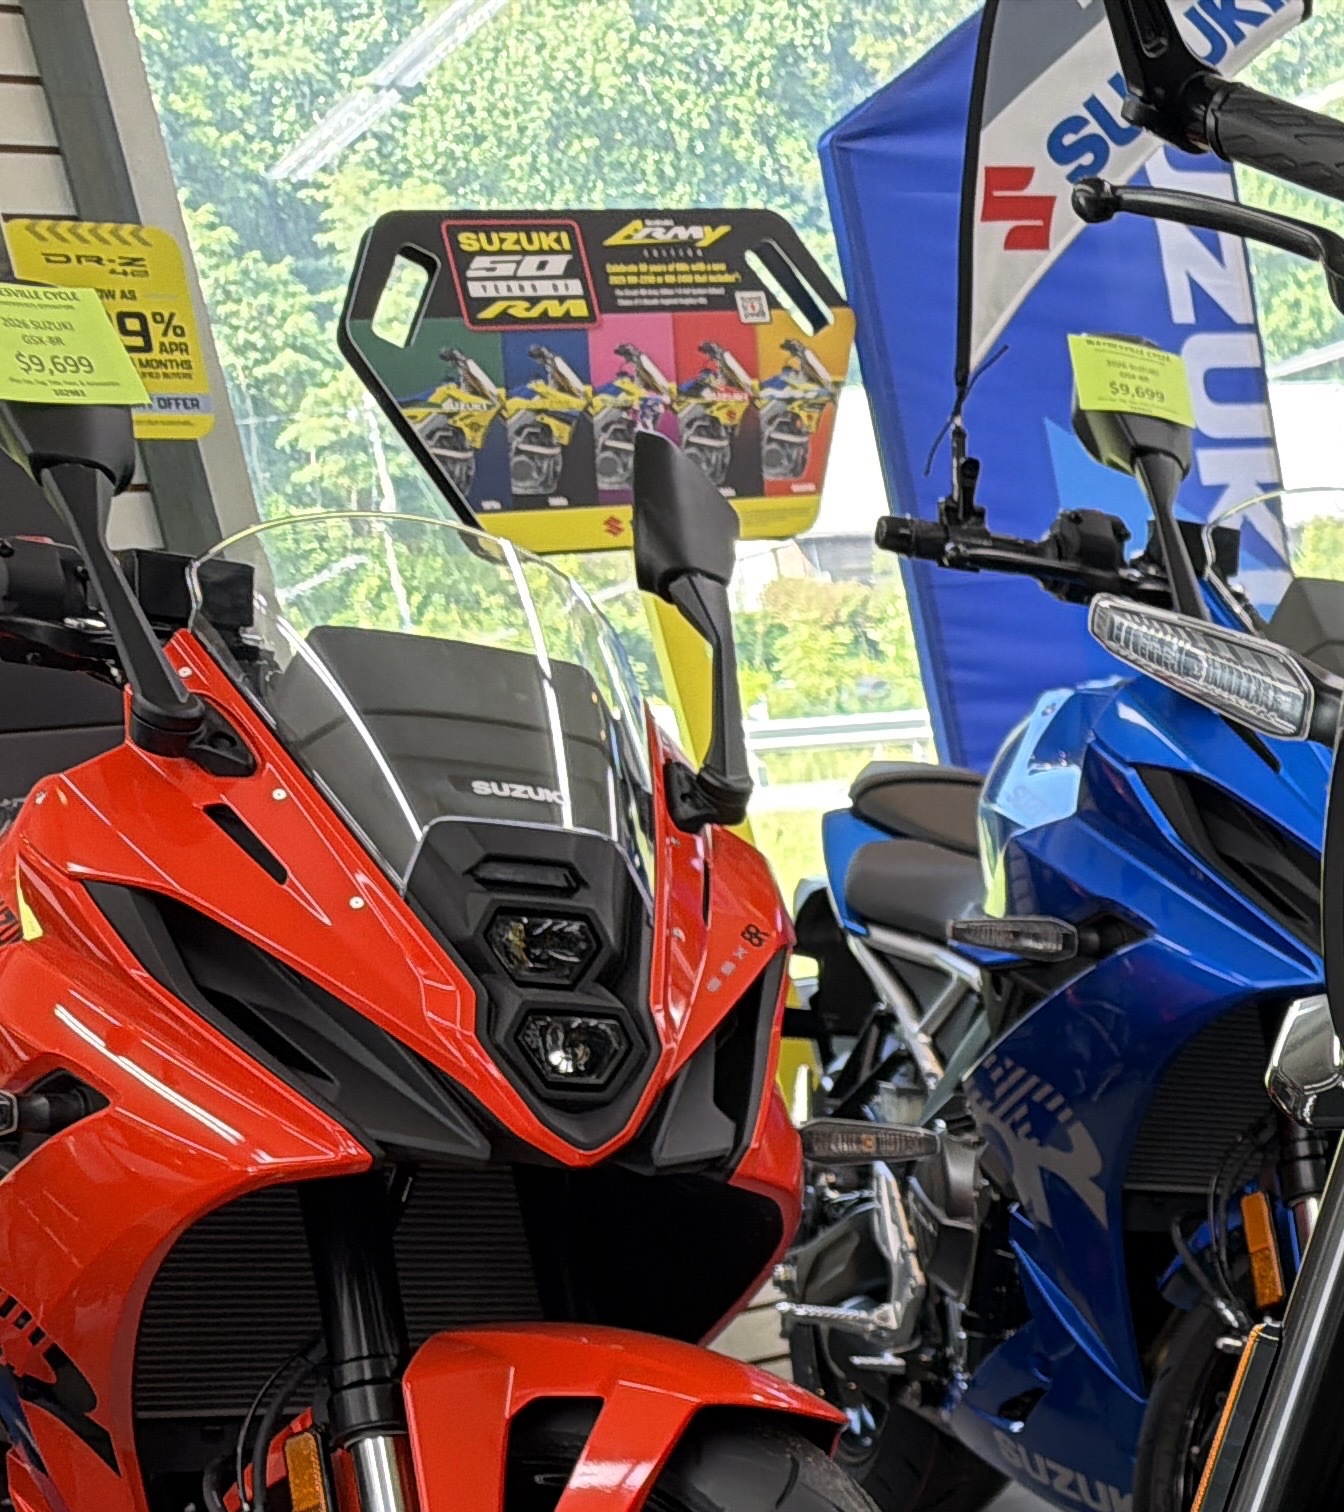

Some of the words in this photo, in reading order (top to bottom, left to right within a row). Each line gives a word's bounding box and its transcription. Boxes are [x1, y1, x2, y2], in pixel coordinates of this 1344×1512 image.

[458, 231, 571, 252] SUZUKI
[43, 253, 147, 268] DR-Z
[466, 255, 573, 277] 50
[45, 290, 80, 302] CYCLE
[120, 290, 137, 301] AS
[31, 318, 75, 332] SUZUKI
[159, 341, 190, 356] APR
[15, 350, 95, 376] $9,699
[138, 357, 193, 371] MONTHS
[1108, 380, 1165, 404] $9,699
[157, 397, 200, 410] OFFER
[471, 780, 565, 806] SUZUK
